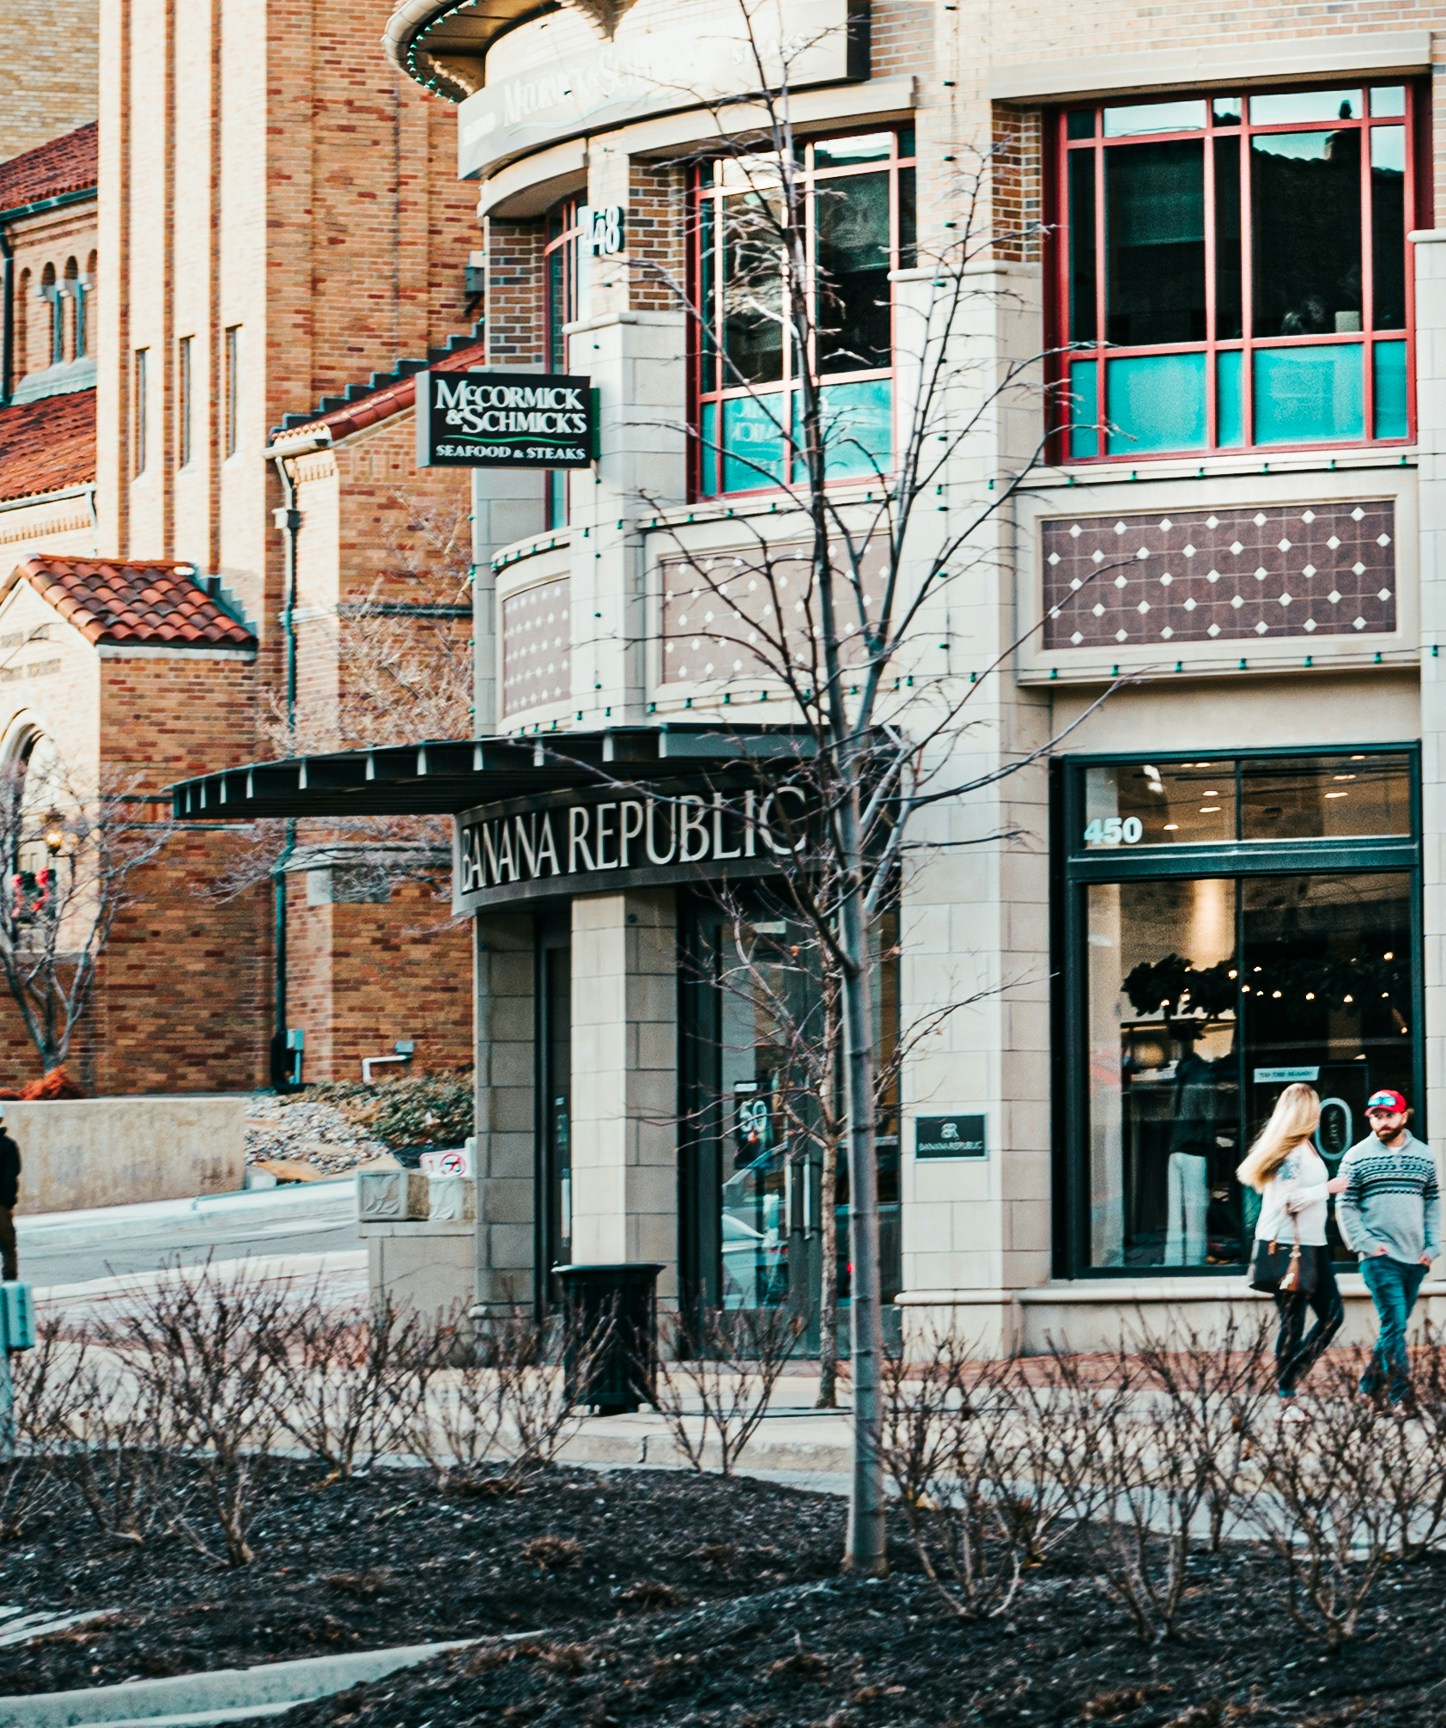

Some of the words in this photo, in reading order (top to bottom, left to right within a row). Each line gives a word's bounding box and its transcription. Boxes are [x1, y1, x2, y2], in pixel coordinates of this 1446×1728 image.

[434, 379, 585, 410] McCORMICK
[435, 444, 511, 458] SEAFOOD
[513, 449, 524, 459] &
[526, 446, 587, 460] STEAKS
[462, 810, 561, 892] BANANA
[568, 785, 807, 873] REPUBLIC
[1083, 816, 1143, 845] 450
[739, 1100, 768, 1132] 50
